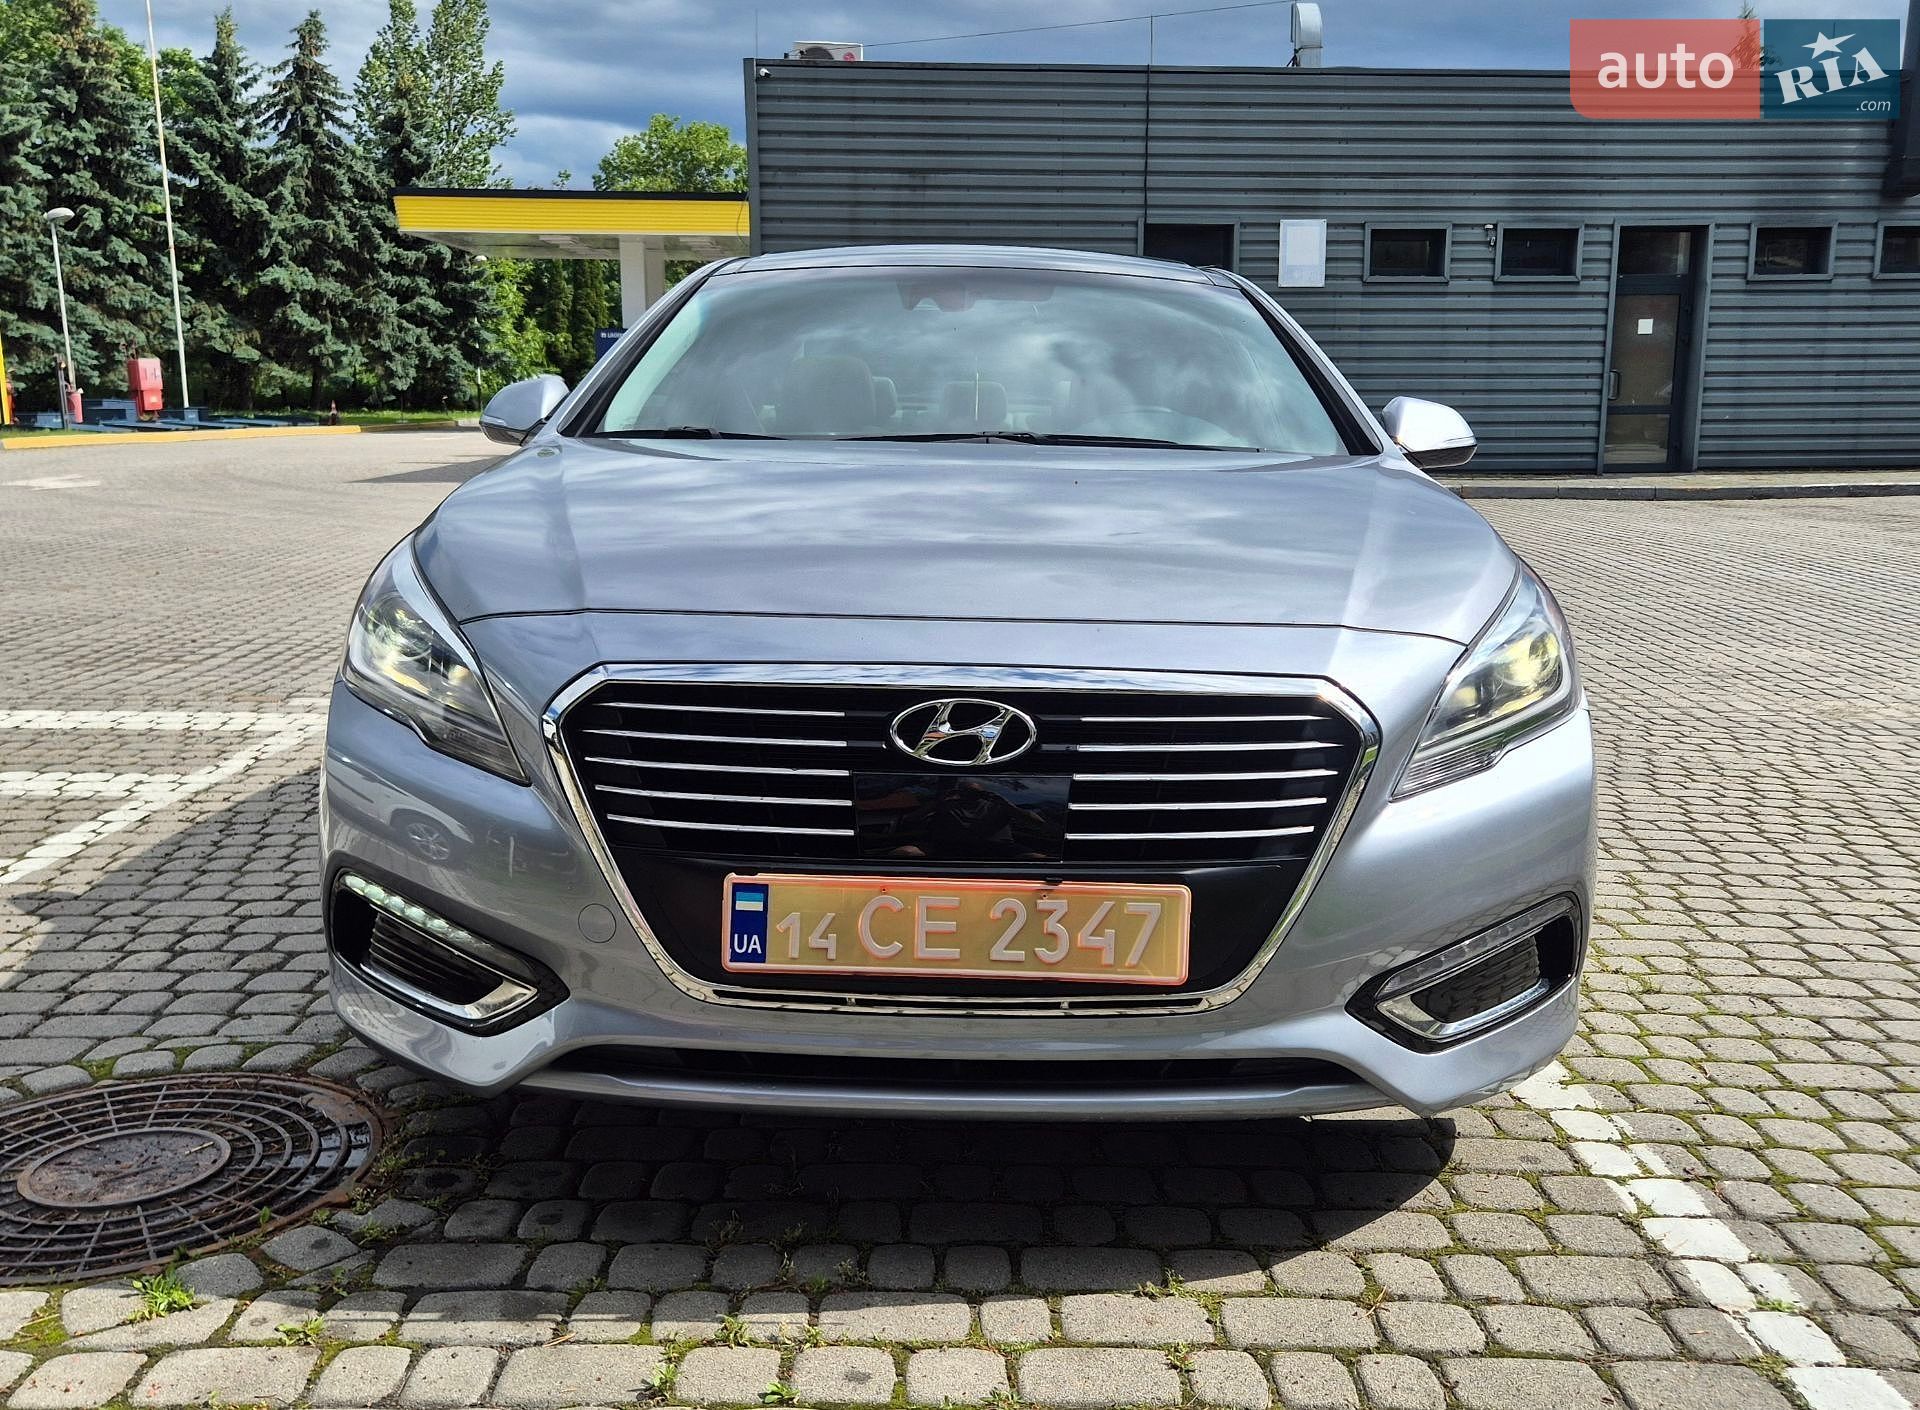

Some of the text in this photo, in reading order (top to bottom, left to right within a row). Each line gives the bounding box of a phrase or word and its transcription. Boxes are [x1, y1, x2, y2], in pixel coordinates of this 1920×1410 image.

[733, 933, 762, 954] UA
[776, 895, 1162, 968] 14 CE 2347
